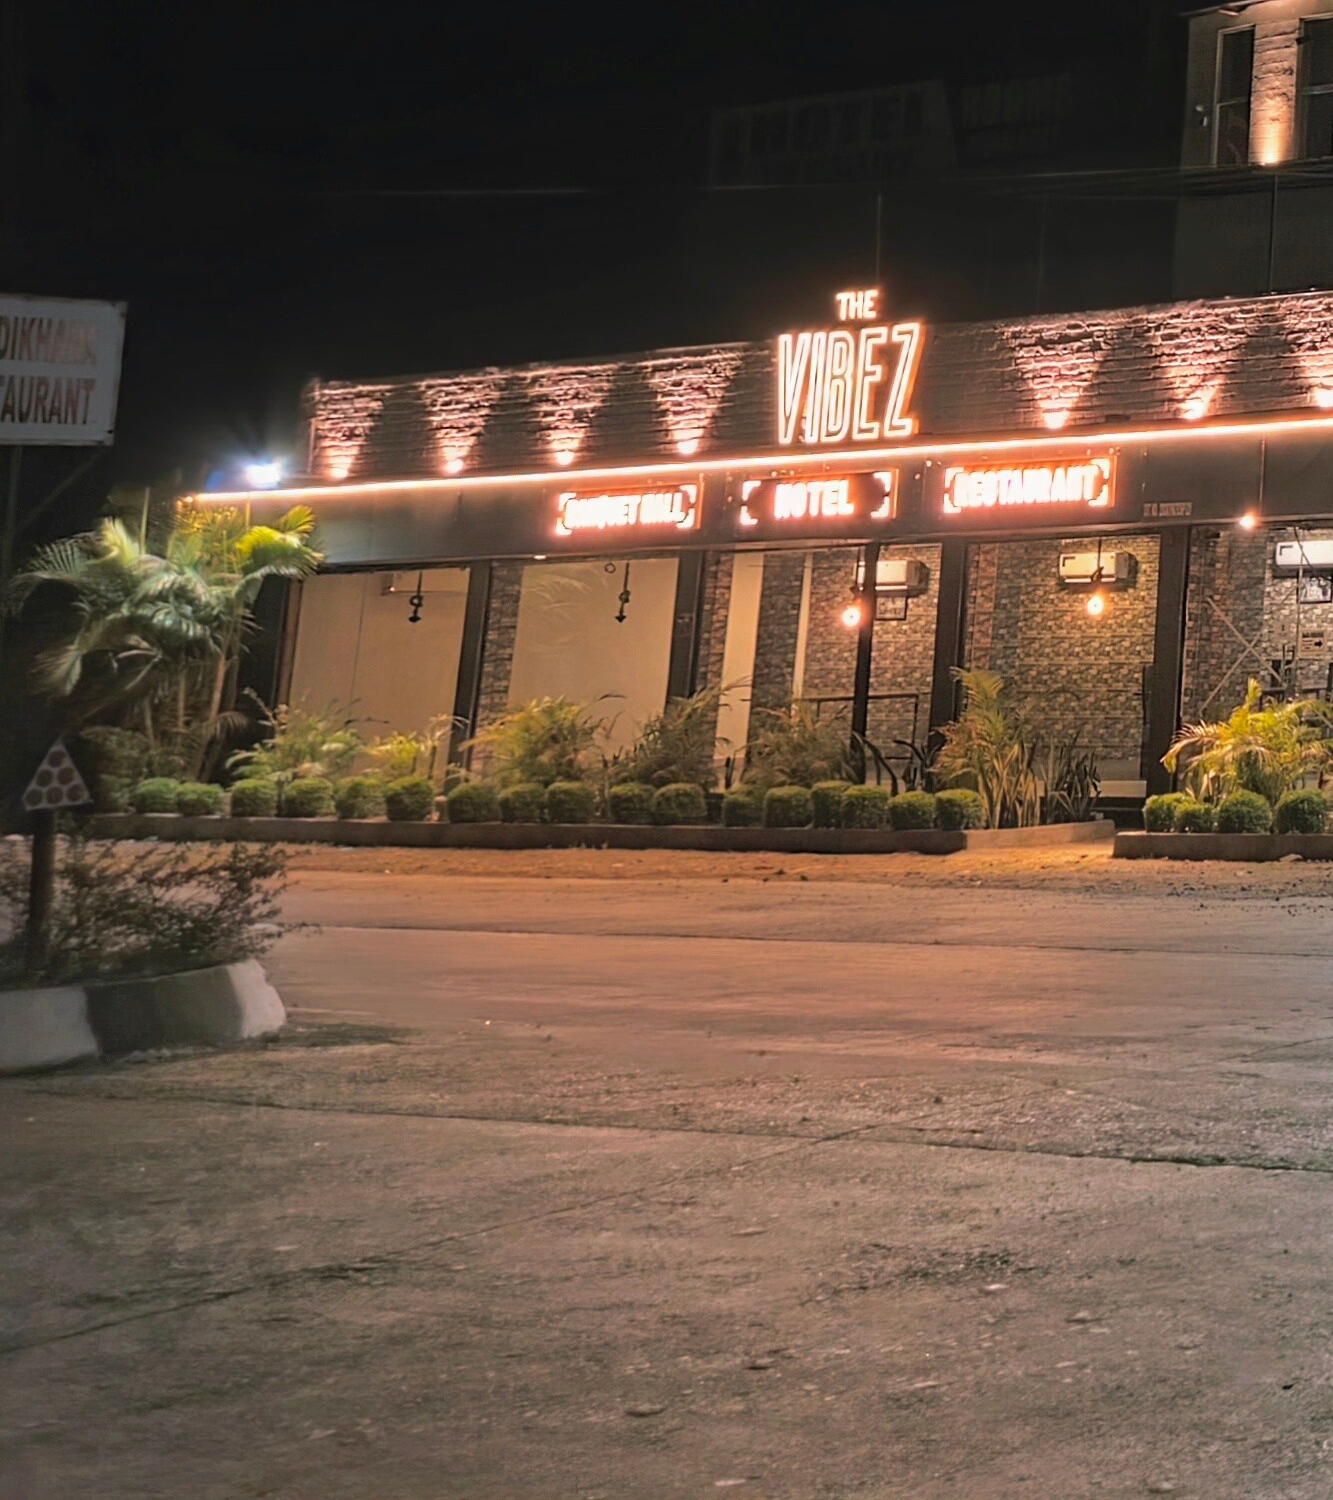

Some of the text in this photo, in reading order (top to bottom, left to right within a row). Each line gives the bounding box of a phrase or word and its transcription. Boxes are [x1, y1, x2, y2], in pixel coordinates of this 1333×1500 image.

[837, 289, 878, 321] THE
[0, 375, 96, 425] AURANT
[778, 323, 919, 443] VIBEZ
[774, 480, 854, 519] HOTEL
